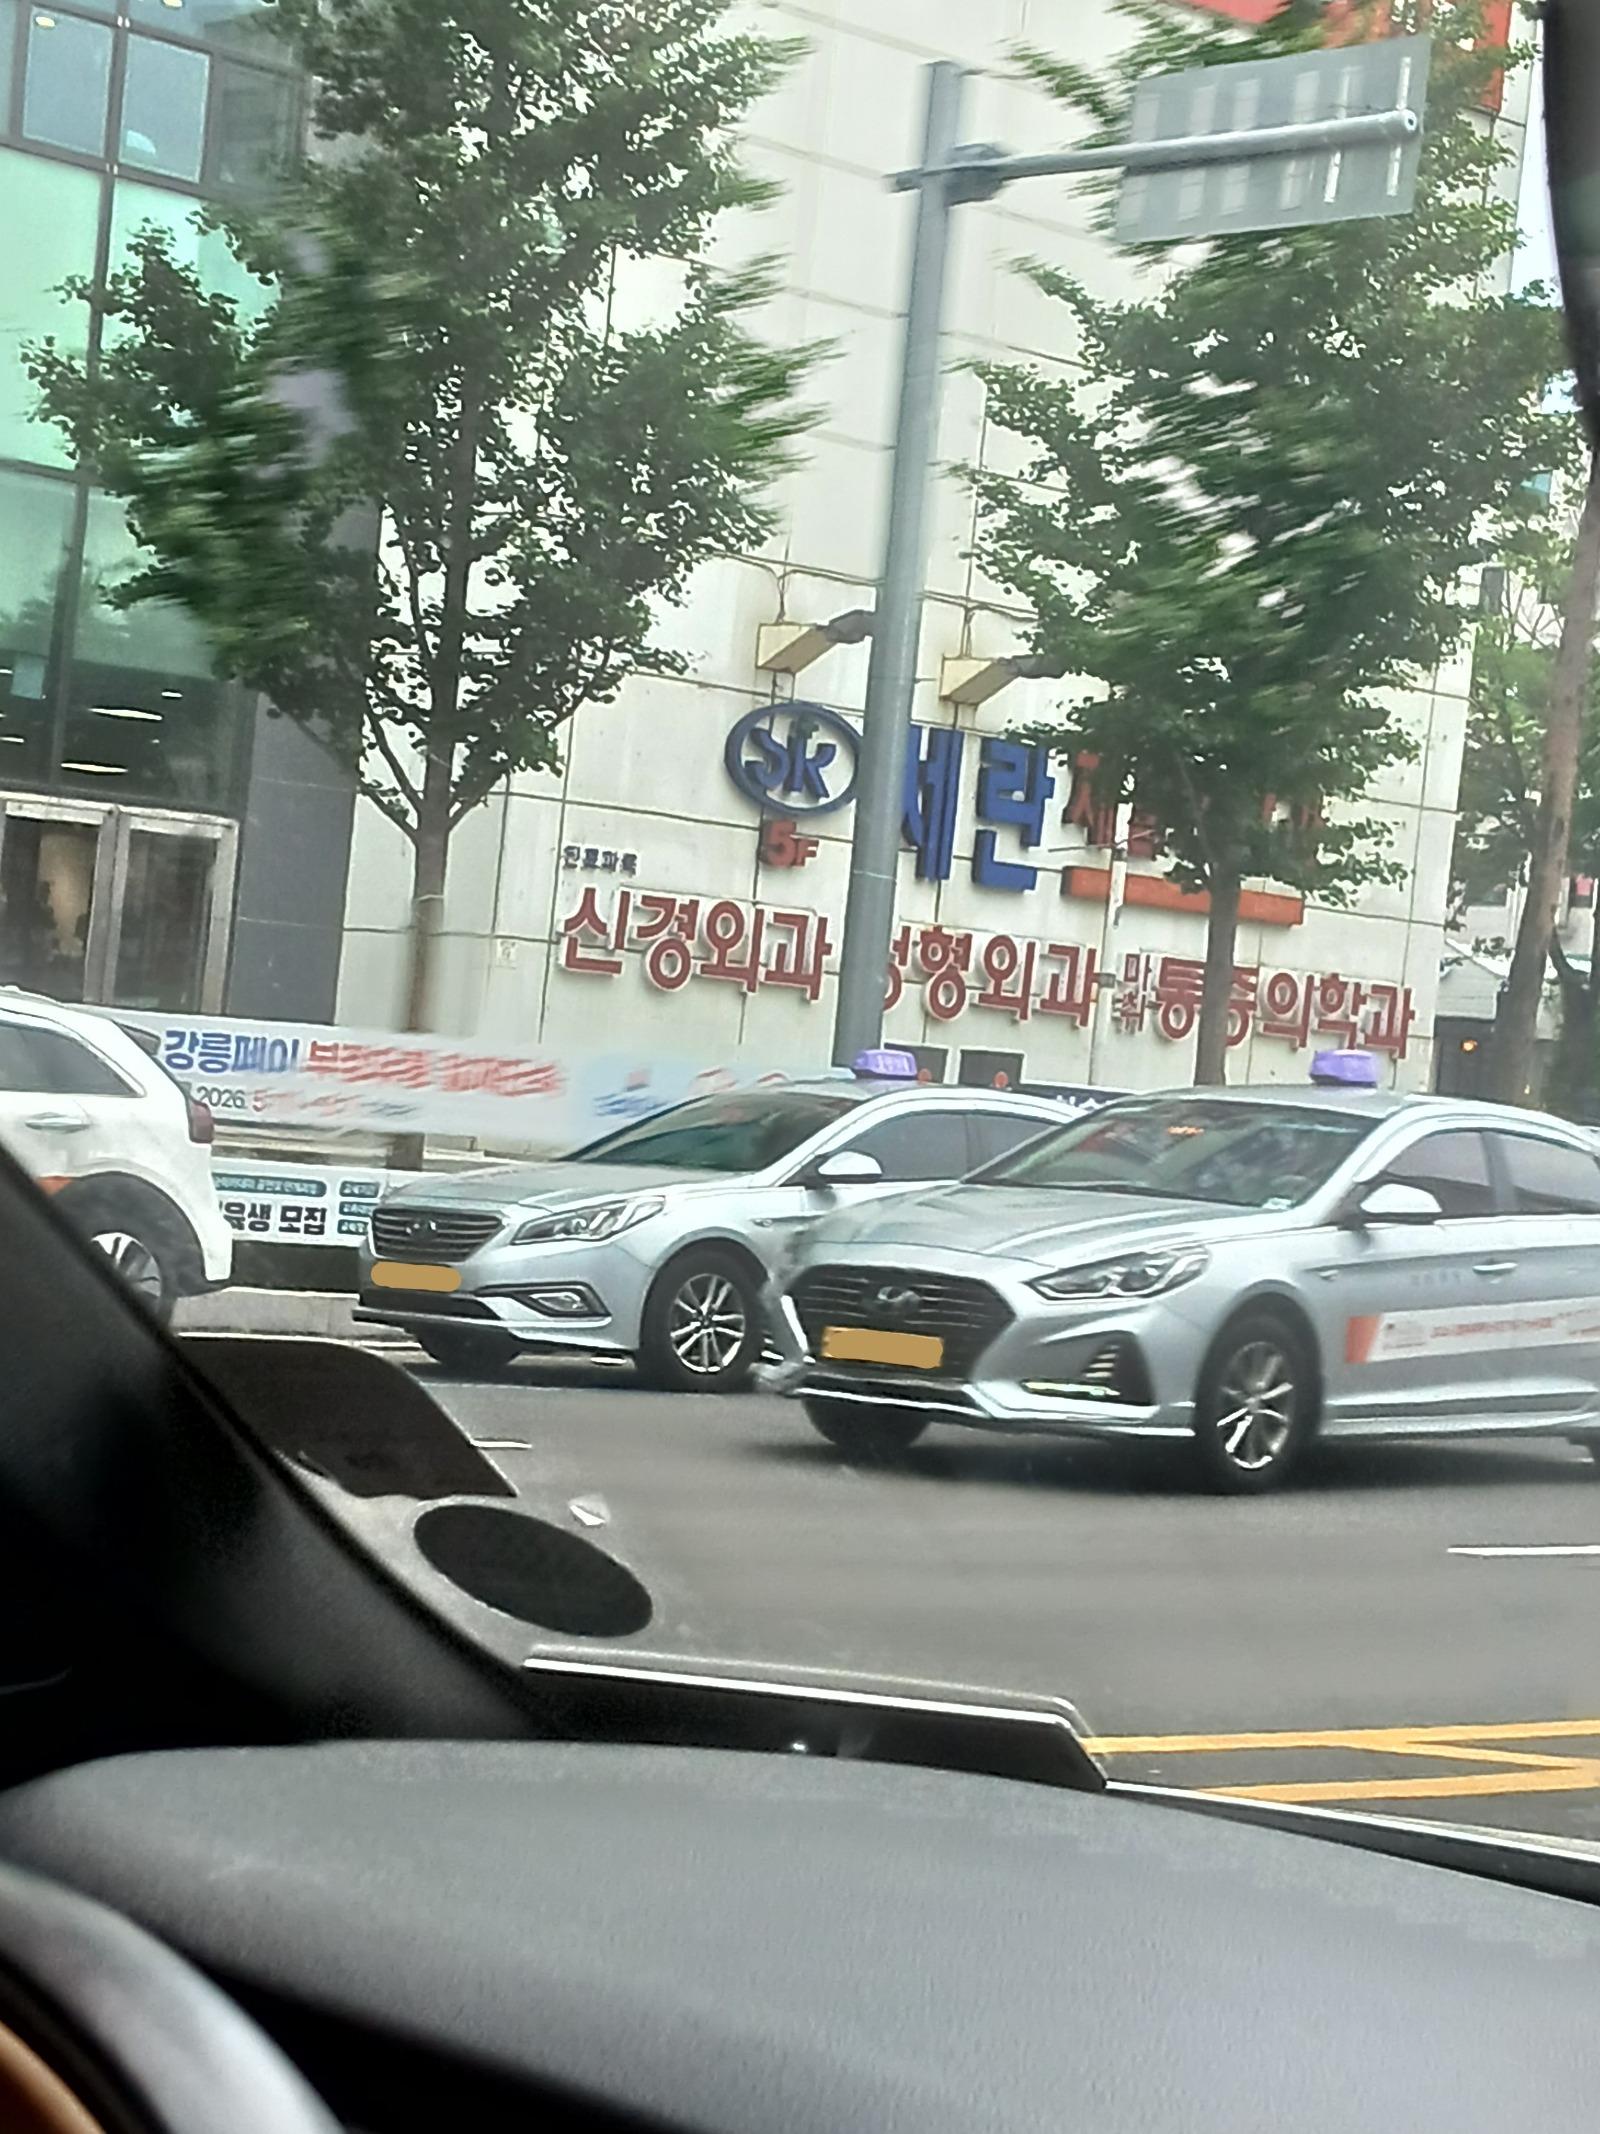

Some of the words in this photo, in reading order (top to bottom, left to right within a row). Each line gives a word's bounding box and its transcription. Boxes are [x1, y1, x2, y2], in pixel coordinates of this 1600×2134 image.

[762, 820, 819, 869] 5F
[564, 887, 833, 1002] 신경외과
[165, 1030, 300, 1074] 강릉페이
[219, 1200, 272, 1232] 육생
[278, 1205, 327, 1236] 모집
